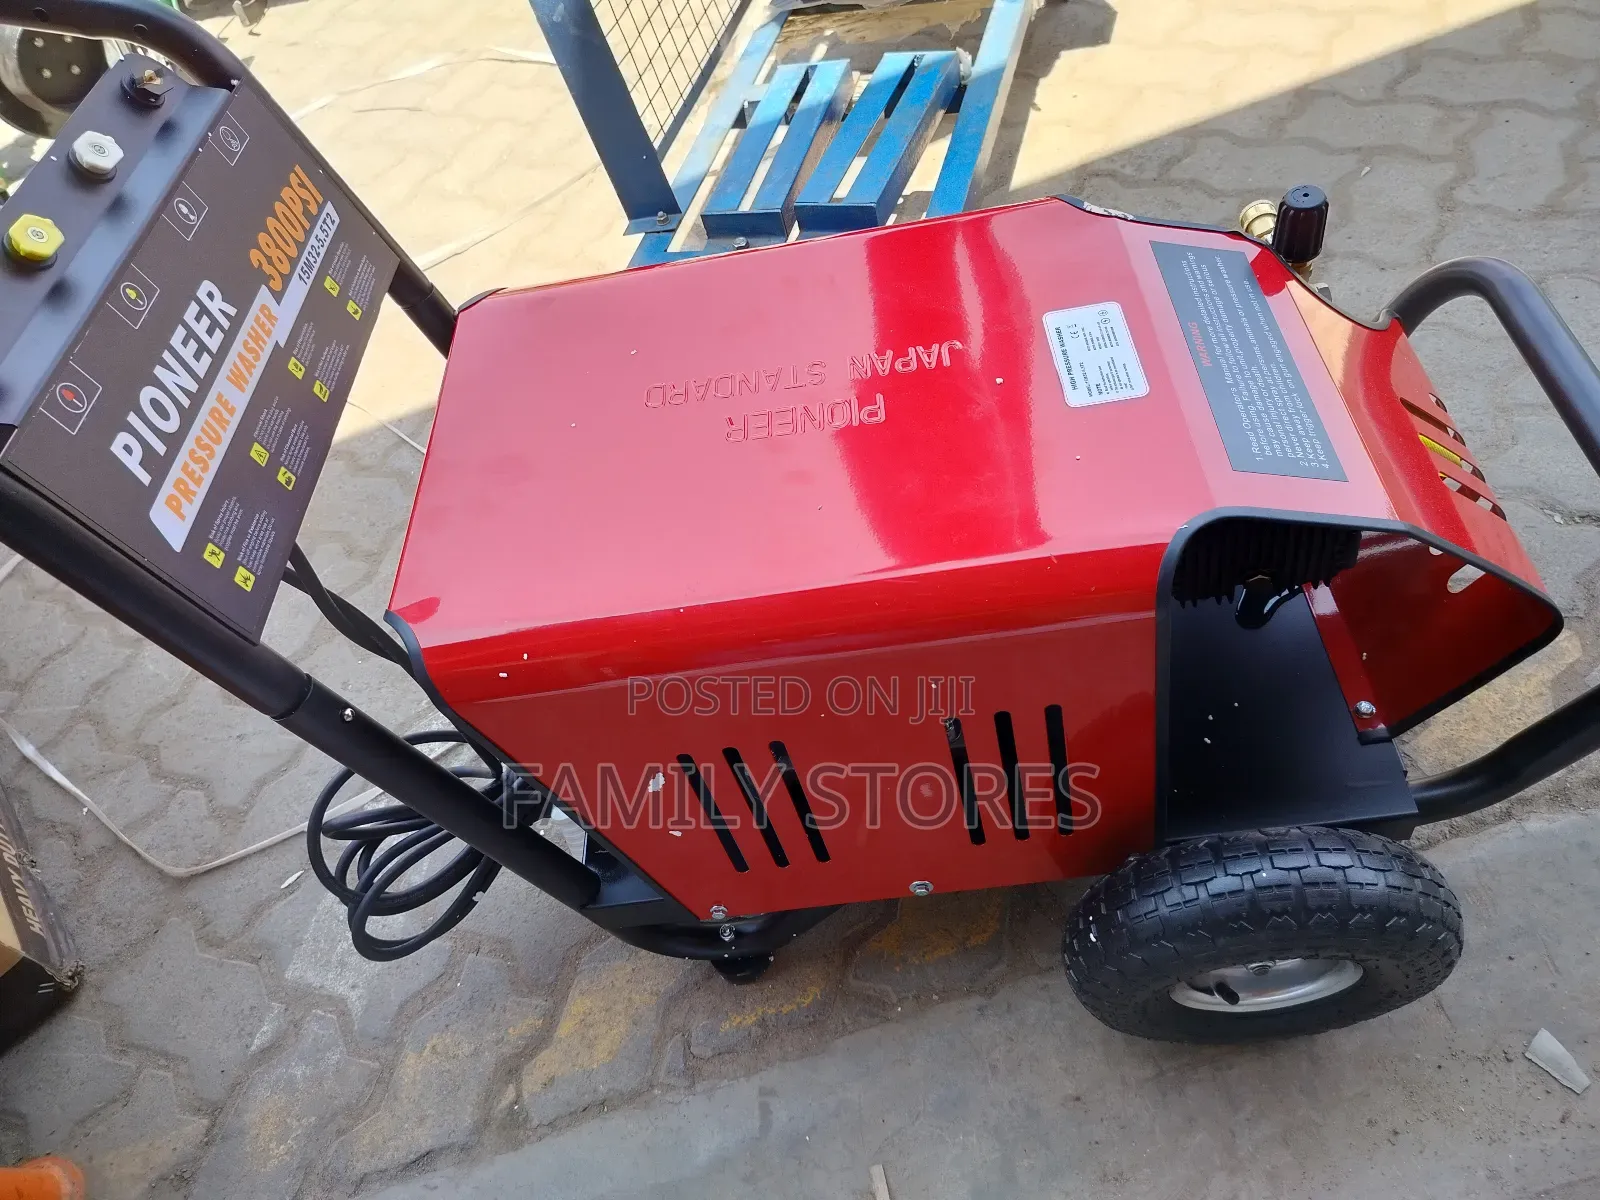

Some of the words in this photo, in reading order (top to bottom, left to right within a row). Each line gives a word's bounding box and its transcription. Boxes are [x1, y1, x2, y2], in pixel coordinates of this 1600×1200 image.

[249, 165, 324, 293] 3800PSI
[298, 211, 338, 286] 15M32-5.5T2
[1182, 261, 1199, 296] instructions
[1197, 280, 1207, 292] and
[1201, 265, 1214, 287] serious
[1225, 280, 1243, 308] pressure
[1251, 301, 1261, 311] not
[1195, 298, 1210, 324] detailed
[1204, 294, 1223, 332] instructions
[1214, 297, 1228, 323] damage
[1258, 313, 1269, 330] when
[1055, 327, 1065, 348] WASHER
[1187, 321, 1212, 367] WARNING
[1207, 326, 1218, 344] more
[1264, 332, 1283, 362] engaged
[847, 339, 964, 382] JAPAN
[1061, 349, 1073, 375] PRESSURE
[1214, 345, 1222, 355] for
[1223, 343, 1236, 364] follow
[1217, 357, 1233, 383] Manual
[1232, 365, 1239, 373] to
[1251, 365, 1264, 387] death.
[1271, 363, 1287, 393] children.
[1280, 364, 1292, 377] gun
[110, 279, 238, 487] PIONEER
[644, 361, 827, 409] STANDARD
[1070, 377, 1078, 390] HIGH
[1236, 375, 1250, 401] Failure
[1248, 381, 1264, 410] damage
[1261, 388, 1269, 397] or
[1270, 386, 1283, 406] spray
[1287, 379, 1295, 389] on
[165, 389, 237, 522] PRESSURE
[226, 303, 280, 391] WASHER
[1231, 388, 1251, 429] Operator's
[1265, 398, 1278, 420] injury
[1284, 395, 1296, 413] from
[1291, 393, 1304, 409] lock
[725, 393, 886, 443] PIONEER
[1248, 404, 1261, 427] using.
[1261, 413, 1275, 437] cause
[1278, 409, 1293, 431] direct
[1292, 415, 1305, 435] away
[1300, 410, 1316, 436] trigger
[1257, 429, 1272, 455] before
[1271, 439, 1283, 457] may
[1273, 422, 1296, 458] personal
[8, 867, 45, 937] HEAVY
